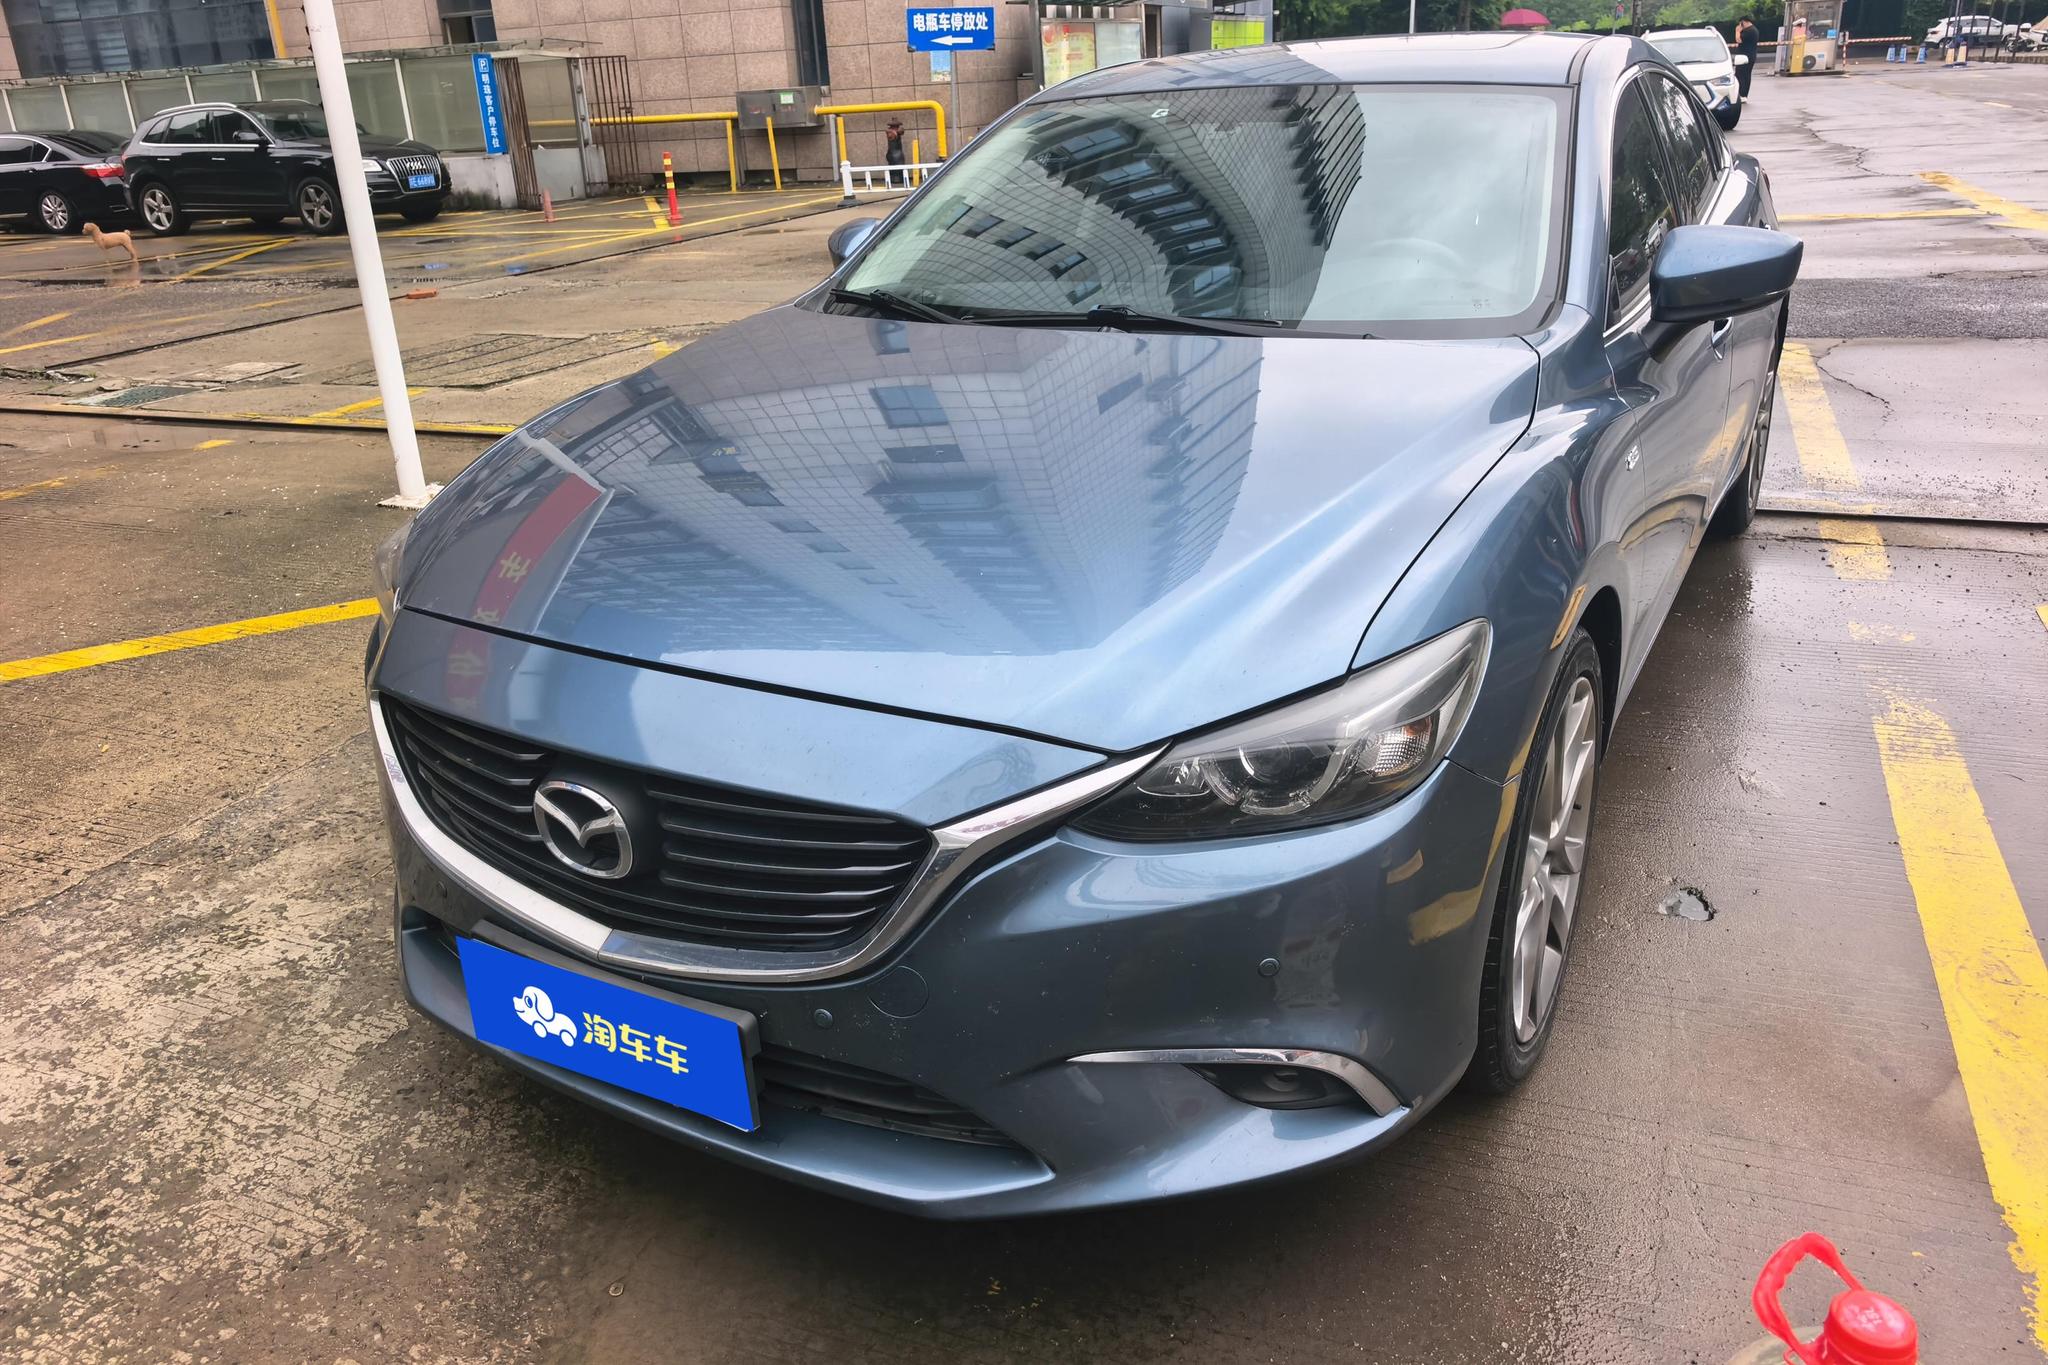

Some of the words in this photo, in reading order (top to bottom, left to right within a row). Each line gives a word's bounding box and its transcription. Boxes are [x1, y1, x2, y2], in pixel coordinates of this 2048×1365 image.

[913, 12, 988, 31] 电瓶车停放处
[479, 59, 488, 71] P
